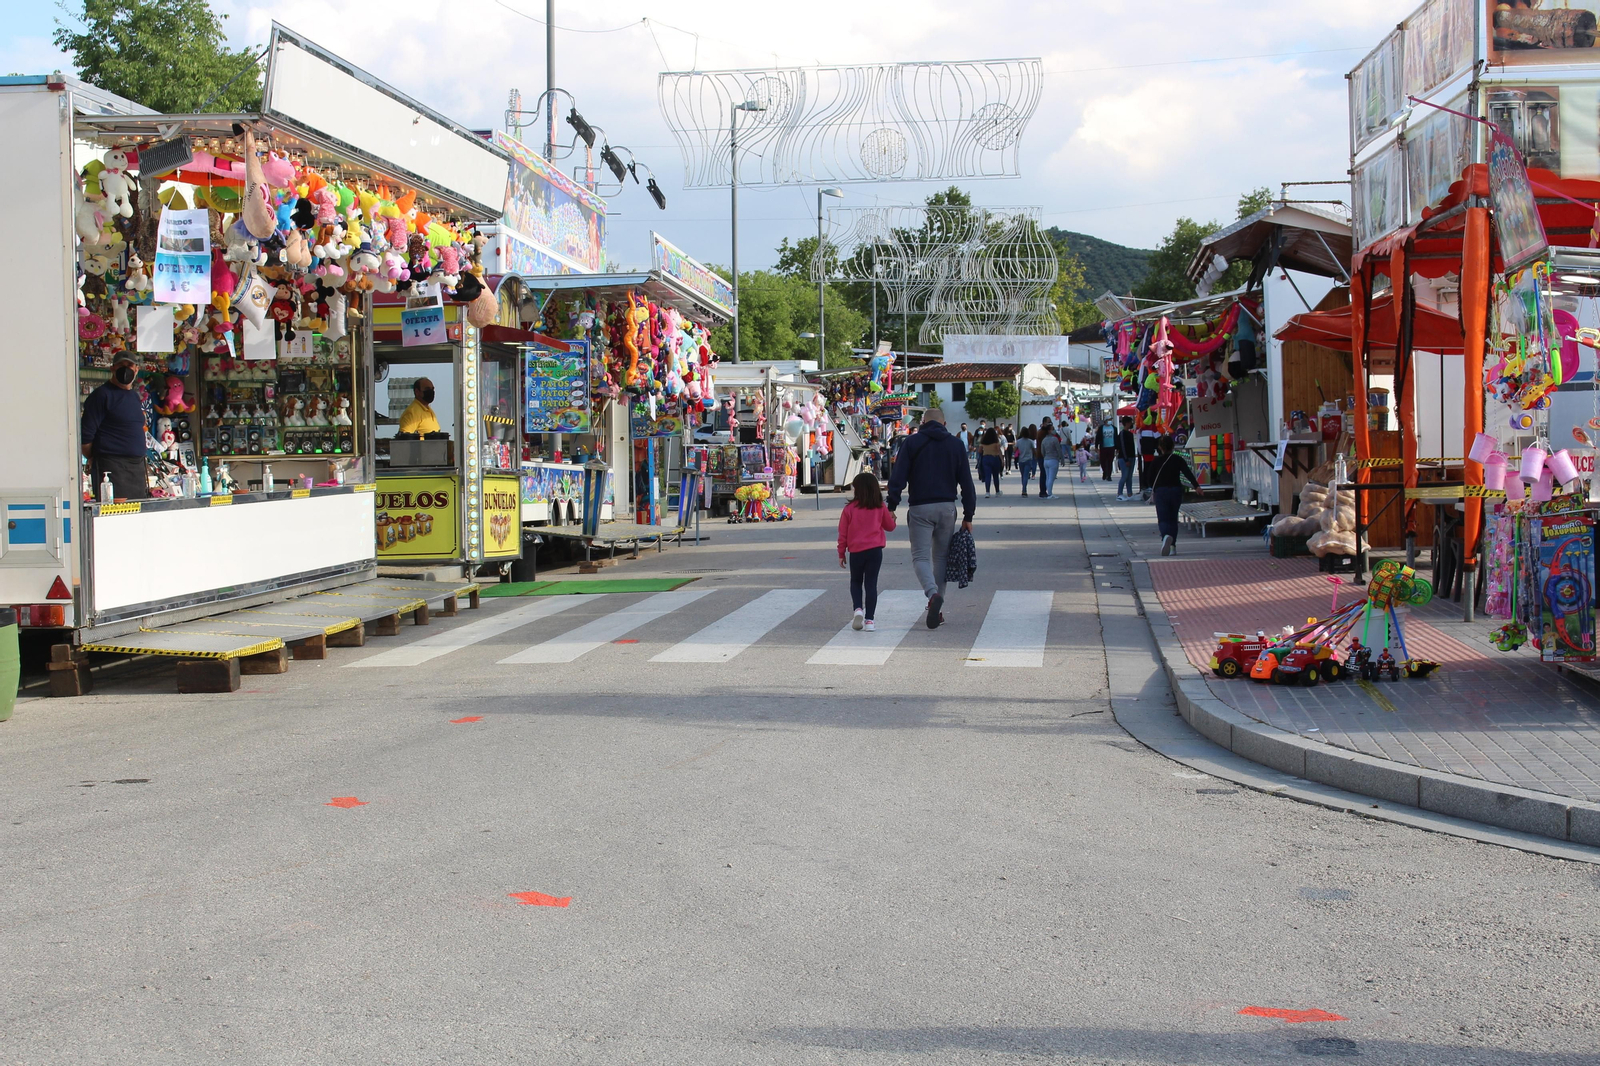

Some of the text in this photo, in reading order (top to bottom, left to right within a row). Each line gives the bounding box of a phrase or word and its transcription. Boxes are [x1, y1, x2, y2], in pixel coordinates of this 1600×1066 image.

[158, 263, 204, 274] OFERTA
[170, 280, 190, 292] 1 €
[405, 315, 440, 325] OFERTA
[414, 328, 431, 337] 1 €
[531, 380, 537, 388] 3
[541, 380, 570, 388] PATOS
[531, 389, 537, 397] 8
[541, 389, 570, 397] PATOS
[1197, 403, 1209, 413] 1€
[1201, 422, 1222, 430] NIÑOS
[484, 489, 516, 510] BUÑUELOS
